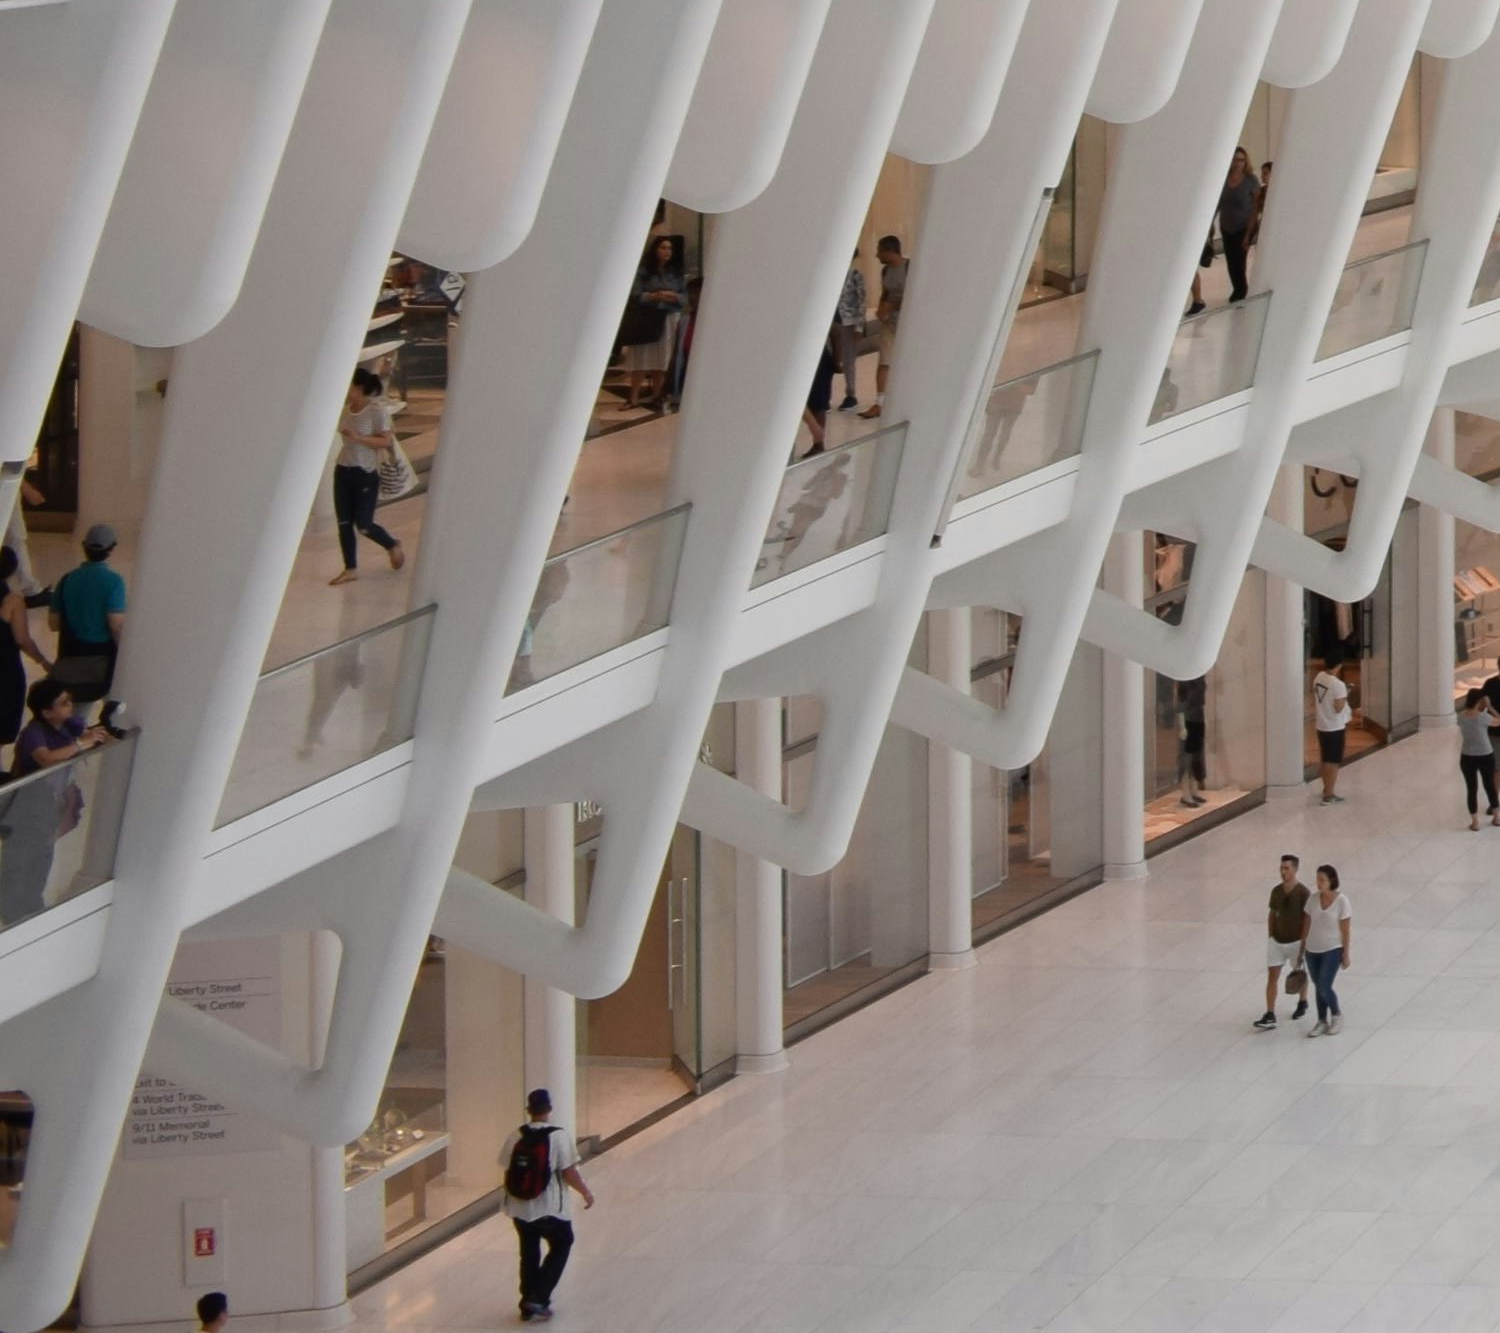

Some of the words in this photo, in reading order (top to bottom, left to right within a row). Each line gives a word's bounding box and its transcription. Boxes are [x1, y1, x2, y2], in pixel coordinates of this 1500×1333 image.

[169, 985, 206, 996] Liberty
[210, 984, 241, 993] Street
[210, 1000, 246, 1011] Center
[143, 1094, 174, 1104] World
[151, 1104, 189, 1116] Liberty
[160, 1119, 210, 1131] Memorial
[151, 1132, 189, 1144] Liberty
[192, 1130, 225, 1141] Street
